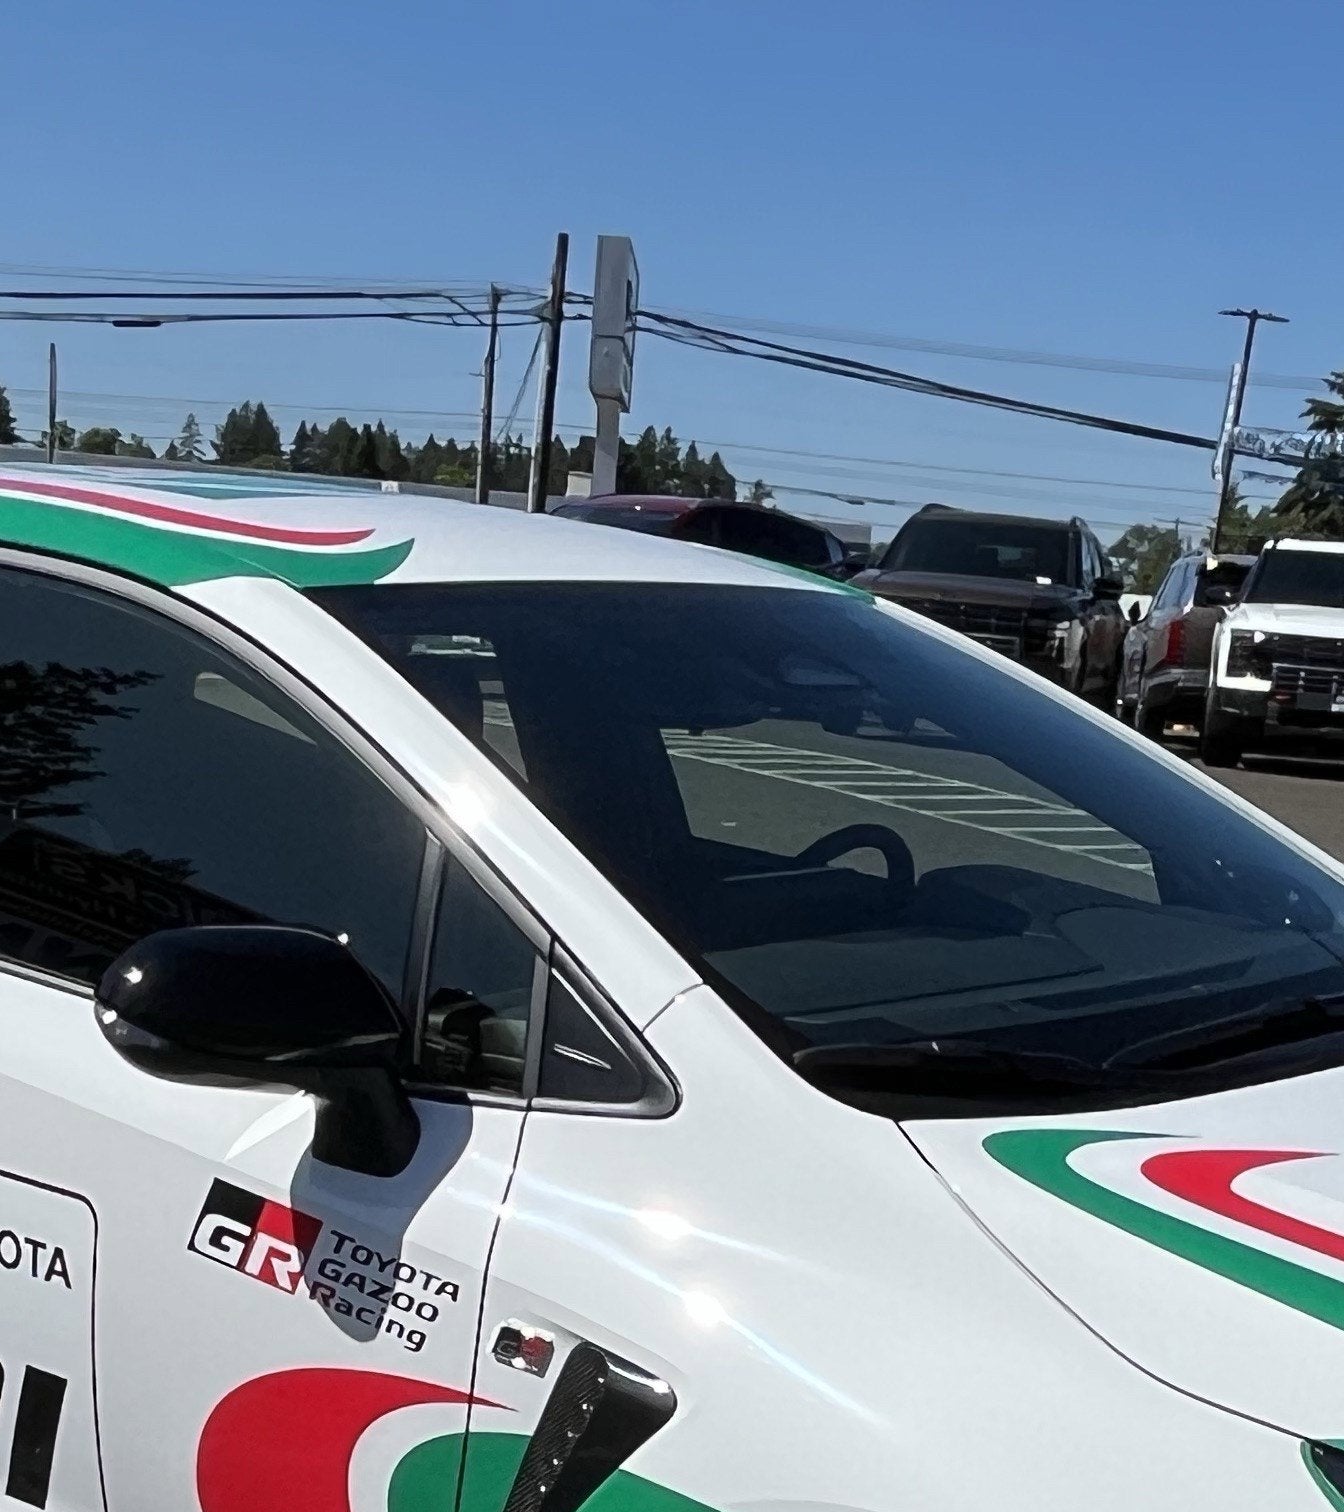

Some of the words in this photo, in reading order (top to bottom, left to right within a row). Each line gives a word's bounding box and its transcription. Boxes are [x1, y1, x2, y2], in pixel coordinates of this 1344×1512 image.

[193, 1212, 303, 1294] GR
[329, 1229, 460, 1303] TOYOTA
[308, 1280, 428, 1353] Racing
[317, 1257, 439, 1323] GAZOO
